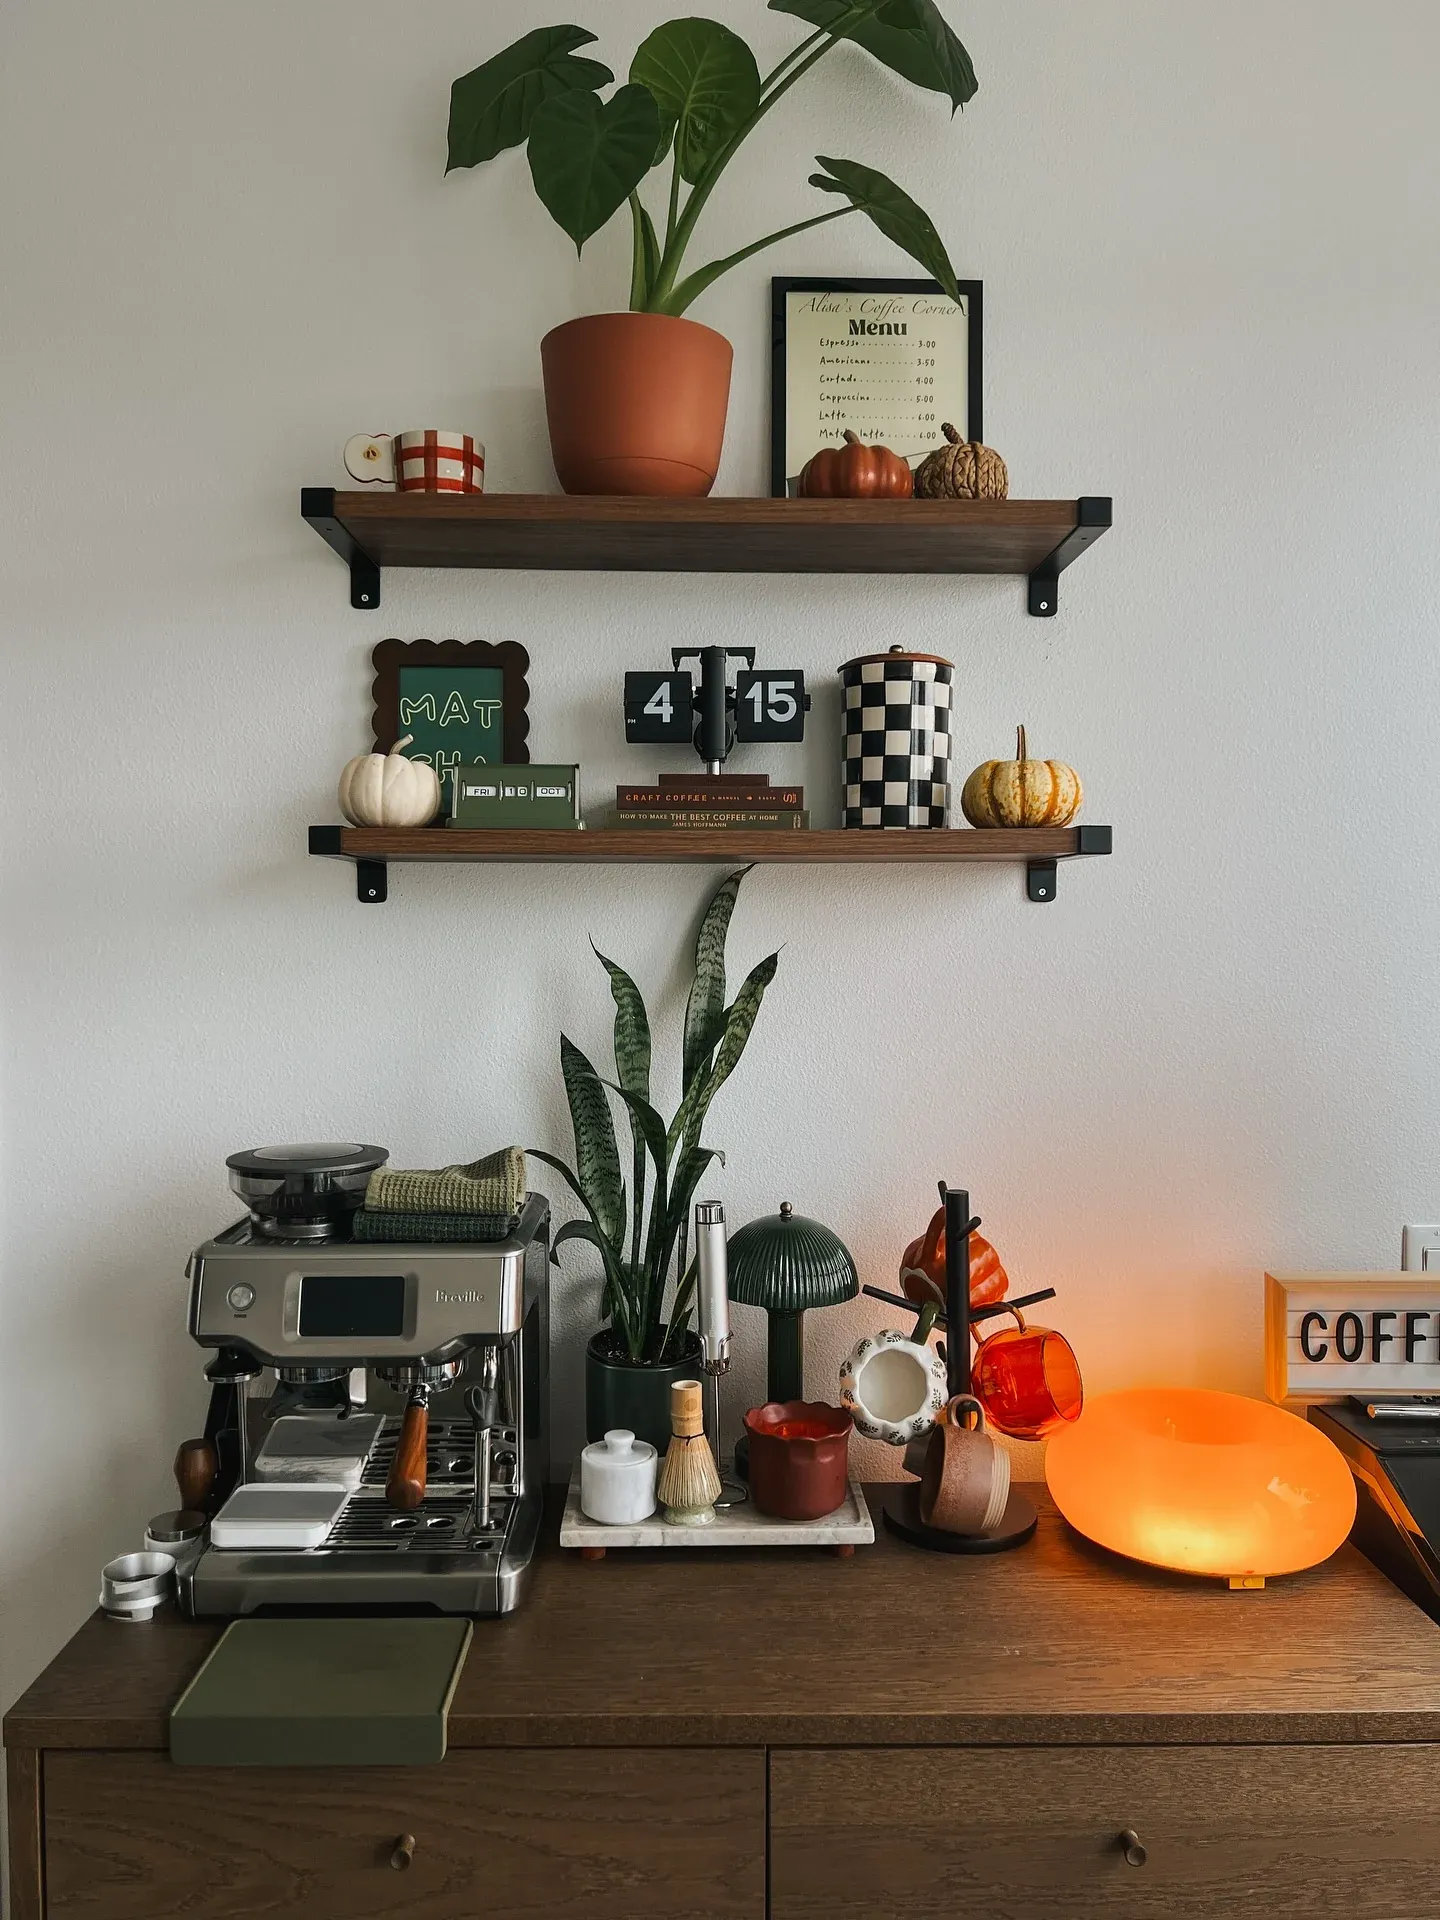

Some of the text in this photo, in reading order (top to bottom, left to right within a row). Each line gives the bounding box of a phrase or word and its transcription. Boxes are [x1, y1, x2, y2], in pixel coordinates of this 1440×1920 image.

[798, 292, 961, 321] Alisa's Coffee Corner
[849, 319, 908, 336] Menu
[819, 338, 937, 349] Espresso 3.00
[819, 356, 935, 367] Americano 3.50
[819, 373, 934, 385] Cortado 4.00
[819, 392, 934, 404] Cappuccino 5.00
[819, 410, 935, 421] Latte 6.00
[860, 428, 885, 439] latte
[919, 431, 937, 440] 6.00
[643, 681, 797, 723] 4 15
[399, 690, 503, 729] MAT
[474, 788, 490, 796] FRI
[540, 787, 561, 795] OCT
[625, 794, 661, 802] CRAFT
[665, 794, 707, 802] COFFEE
[670, 813, 687, 821] THE
[689, 813, 709, 821] BEST
[712, 813, 746, 821] COFFEE
[435, 1289, 485, 1304] Breville
[1300, 1311, 1440, 1363] COFF
